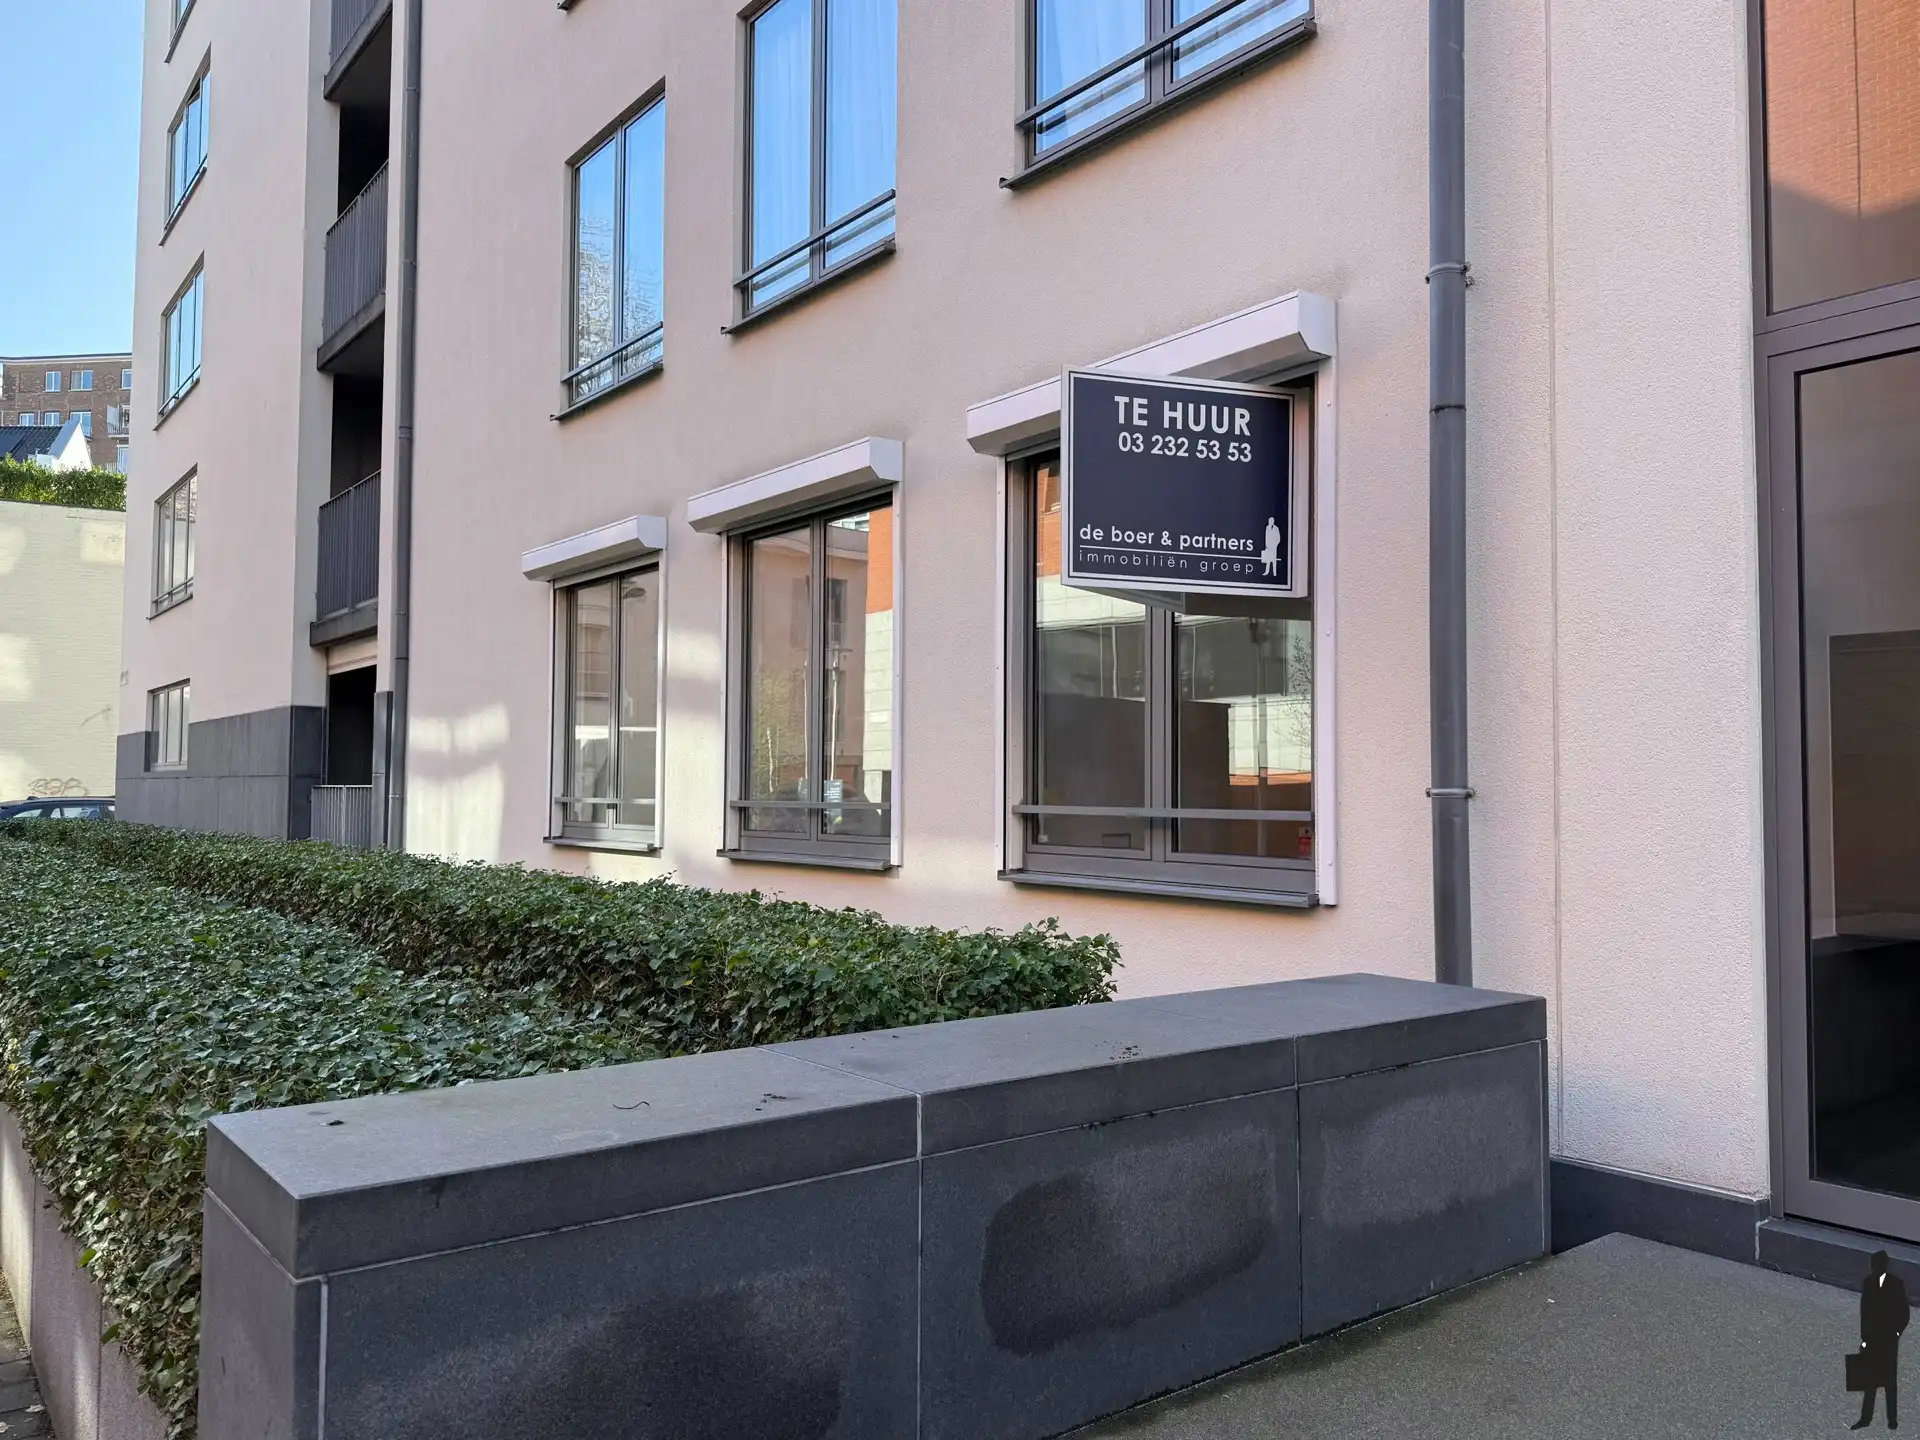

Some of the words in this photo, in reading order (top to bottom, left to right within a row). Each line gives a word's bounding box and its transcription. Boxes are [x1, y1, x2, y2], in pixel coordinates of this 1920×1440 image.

[1114, 395, 1148, 426] TE
[1163, 401, 1251, 436] HUUR
[1118, 431, 1144, 453] 03
[1150, 434, 1189, 457] 232
[1196, 439, 1221, 460] 53
[1227, 442, 1252, 463] 53
[1080, 524, 1104, 541] de
[1111, 526, 1155, 544] boer
[1161, 531, 1172, 547] &
[1180, 533, 1254, 551] partners
[1079, 550, 1188, 569] immobiliën
[1200, 561, 1254, 574] groep
